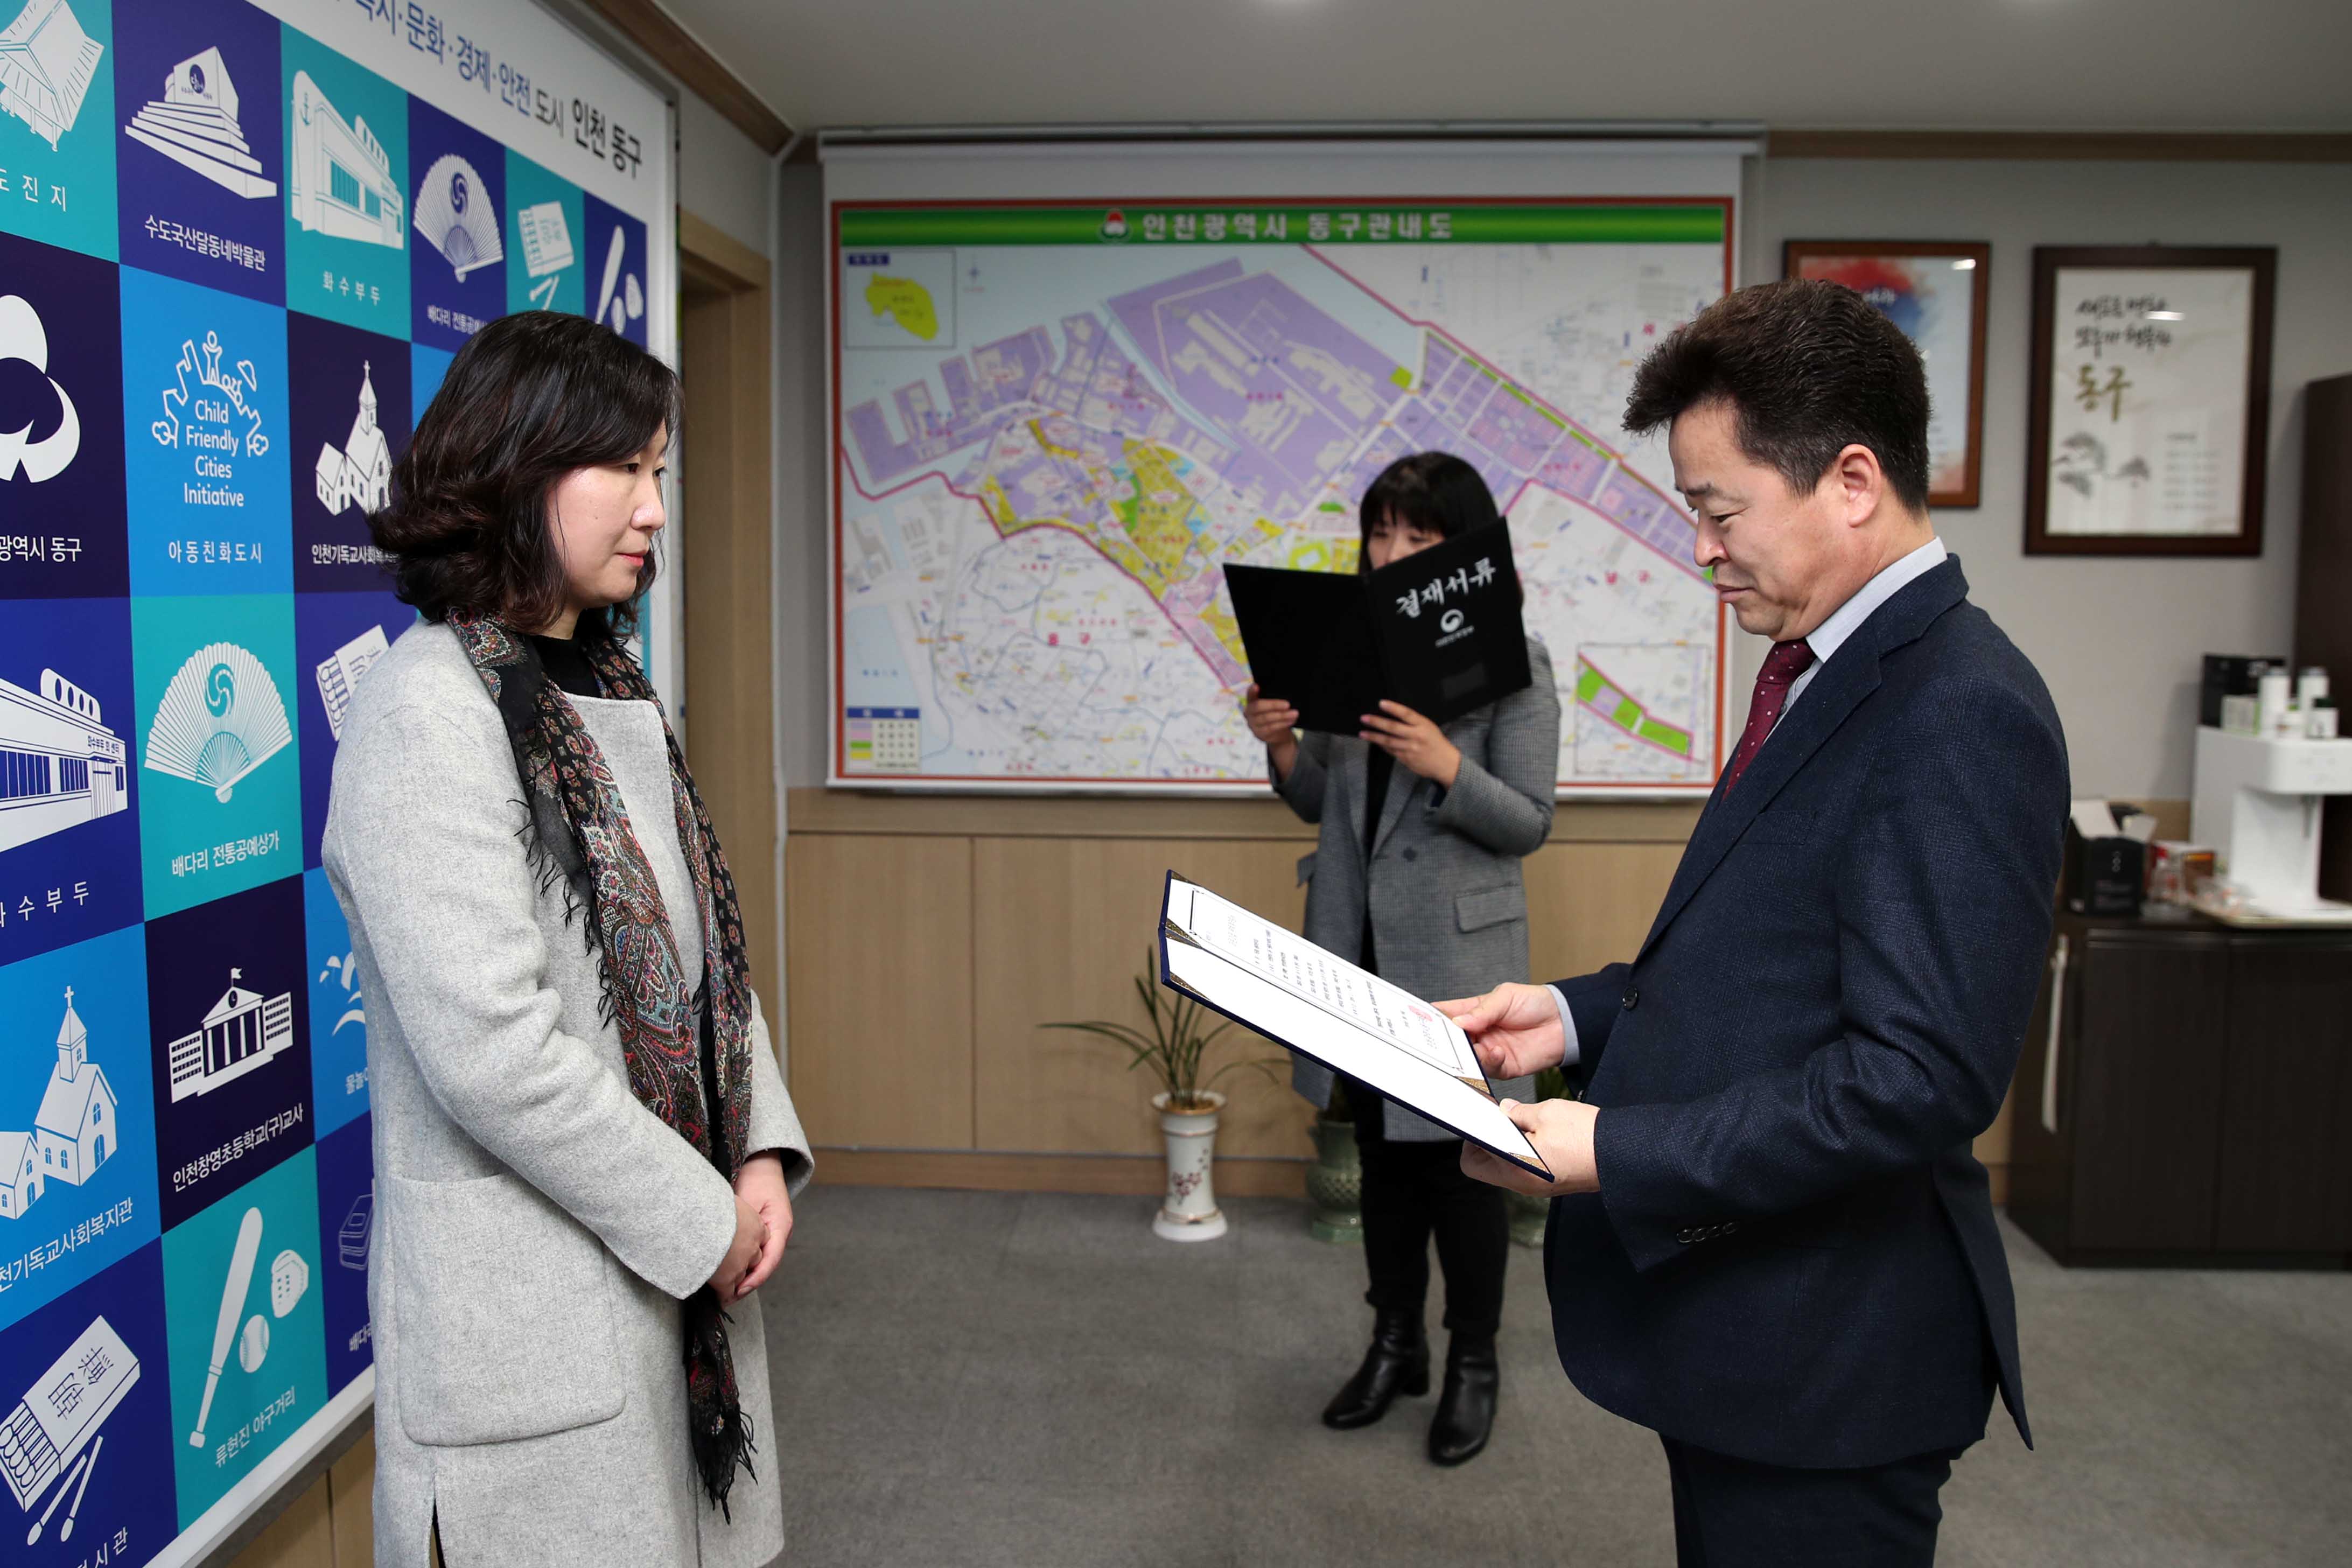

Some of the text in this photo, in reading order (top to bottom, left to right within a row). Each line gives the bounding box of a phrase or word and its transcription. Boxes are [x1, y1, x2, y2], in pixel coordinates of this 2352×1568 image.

[535, 88, 564, 138] 도시
[572, 98, 605, 159] 인천
[612, 124, 642, 178] 동구
[144, 214, 266, 271] 수도국산달동네박물관
[1142, 211, 1453, 242] 인천광역시 동구관내도
[428, 305, 451, 327] 배다리
[194, 400, 229, 424] Child
[2075, 362, 2133, 423] 동구
[186, 425, 239, 457] Friendly
[194, 456, 232, 479] Cities
[184, 482, 244, 507] Initiative
[51, 537, 82, 562] 동구
[168, 540, 262, 564] 아동친화도시
[1396, 557, 1496, 618] 결재서류
[171, 830, 279, 878] 배다리 전통공예상가
[172, 1102, 304, 1192] 인천창영초등학교(구)교사
[48, 1346, 114, 1420] 朝鮮
[215, 1387, 296, 1468] 류현진 야구거리
